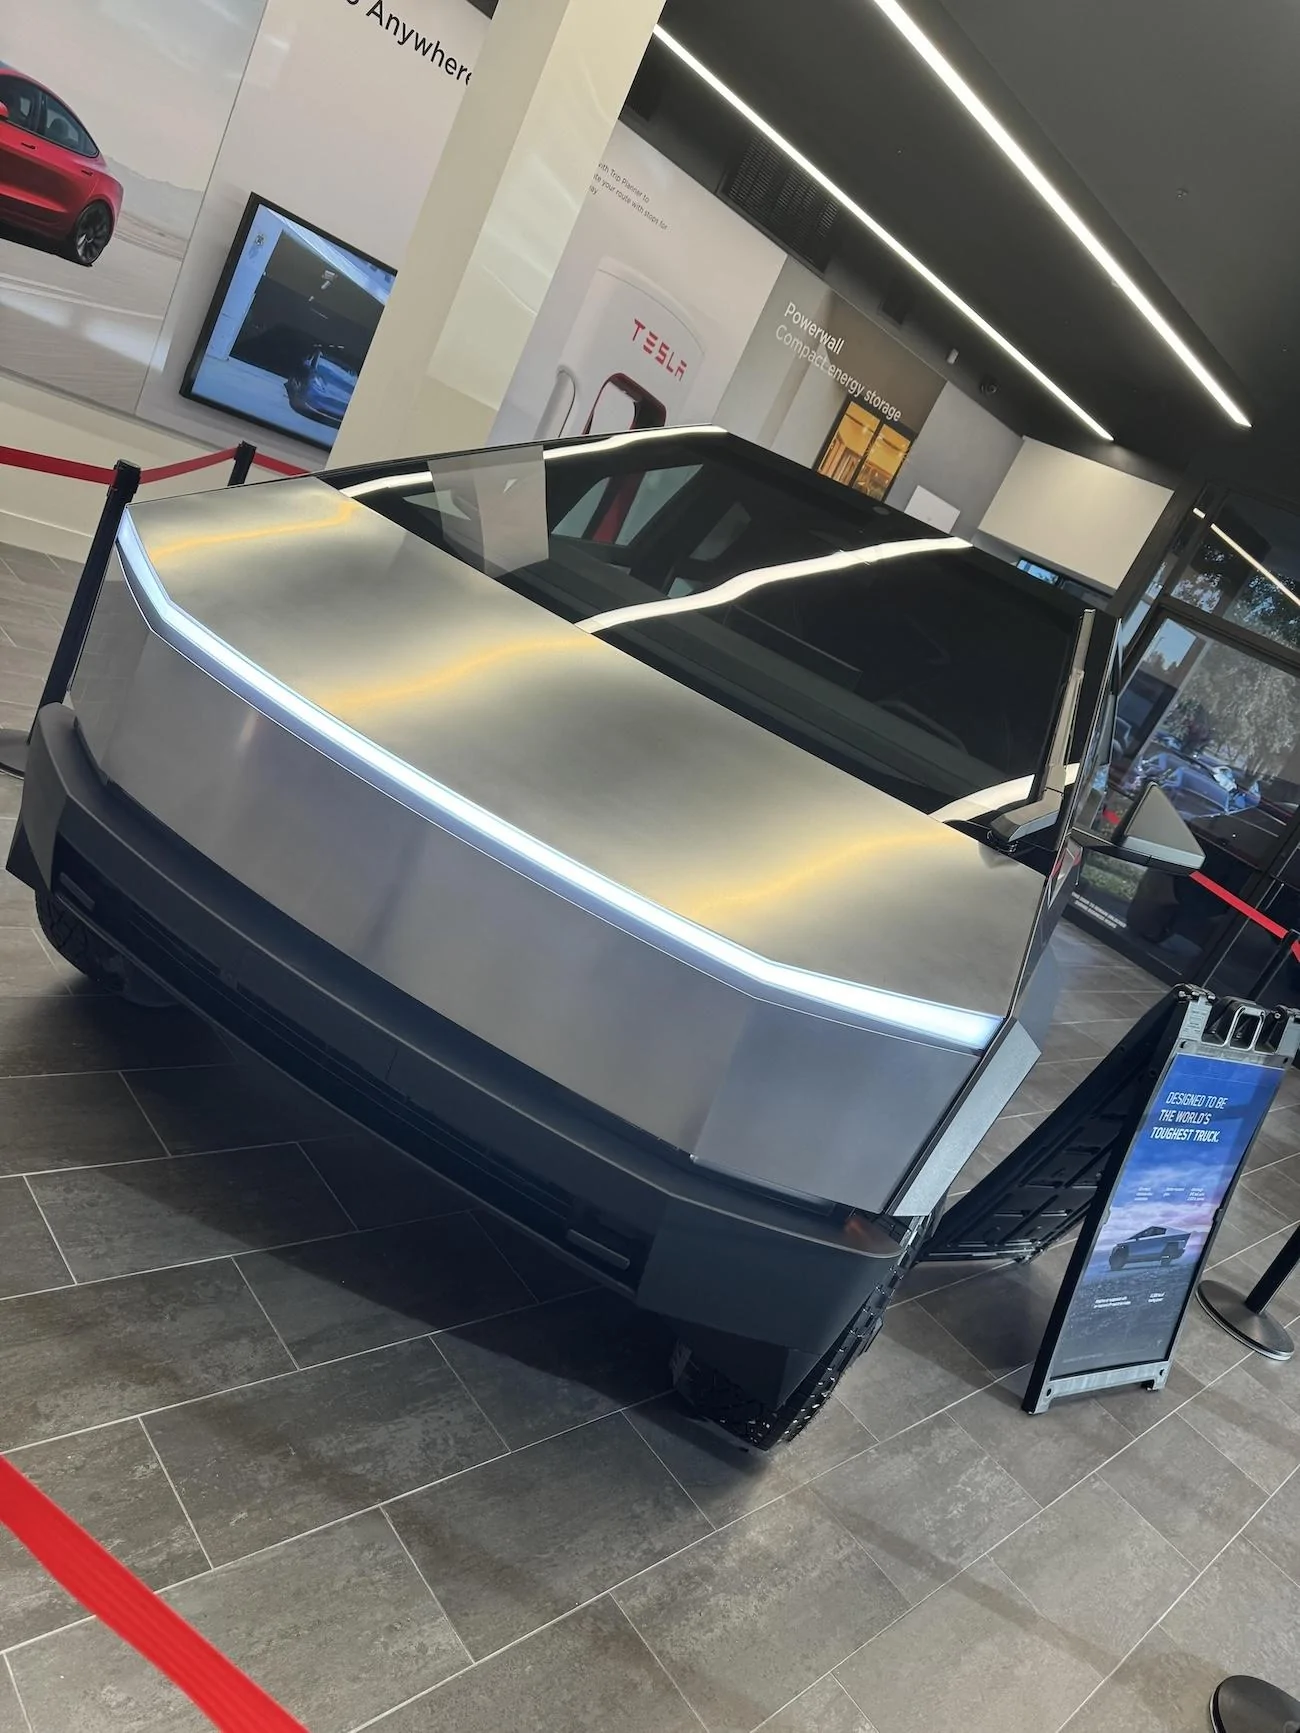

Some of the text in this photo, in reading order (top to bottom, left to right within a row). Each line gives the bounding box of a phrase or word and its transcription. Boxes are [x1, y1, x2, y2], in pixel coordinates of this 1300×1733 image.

[601, 179, 616, 192] your
[615, 189, 631, 204] route
[631, 201, 644, 214] with
[643, 210, 659, 225] stops
[659, 220, 668, 230] for
[610, 169, 621, 182] Trip
[621, 178, 643, 197] Planner
[642, 192, 650, 203] to
[784, 302, 845, 355] Powerwall
[632, 319, 687, 381] TESLA
[775, 324, 902, 422] Compact energy storage
[1159, 1109, 1212, 1125] THE WORLD'S
[1165, 1091, 1229, 1109] DESIGNED TO BE
[1150, 1126, 1220, 1142] TOUGHEST TRUCK.
